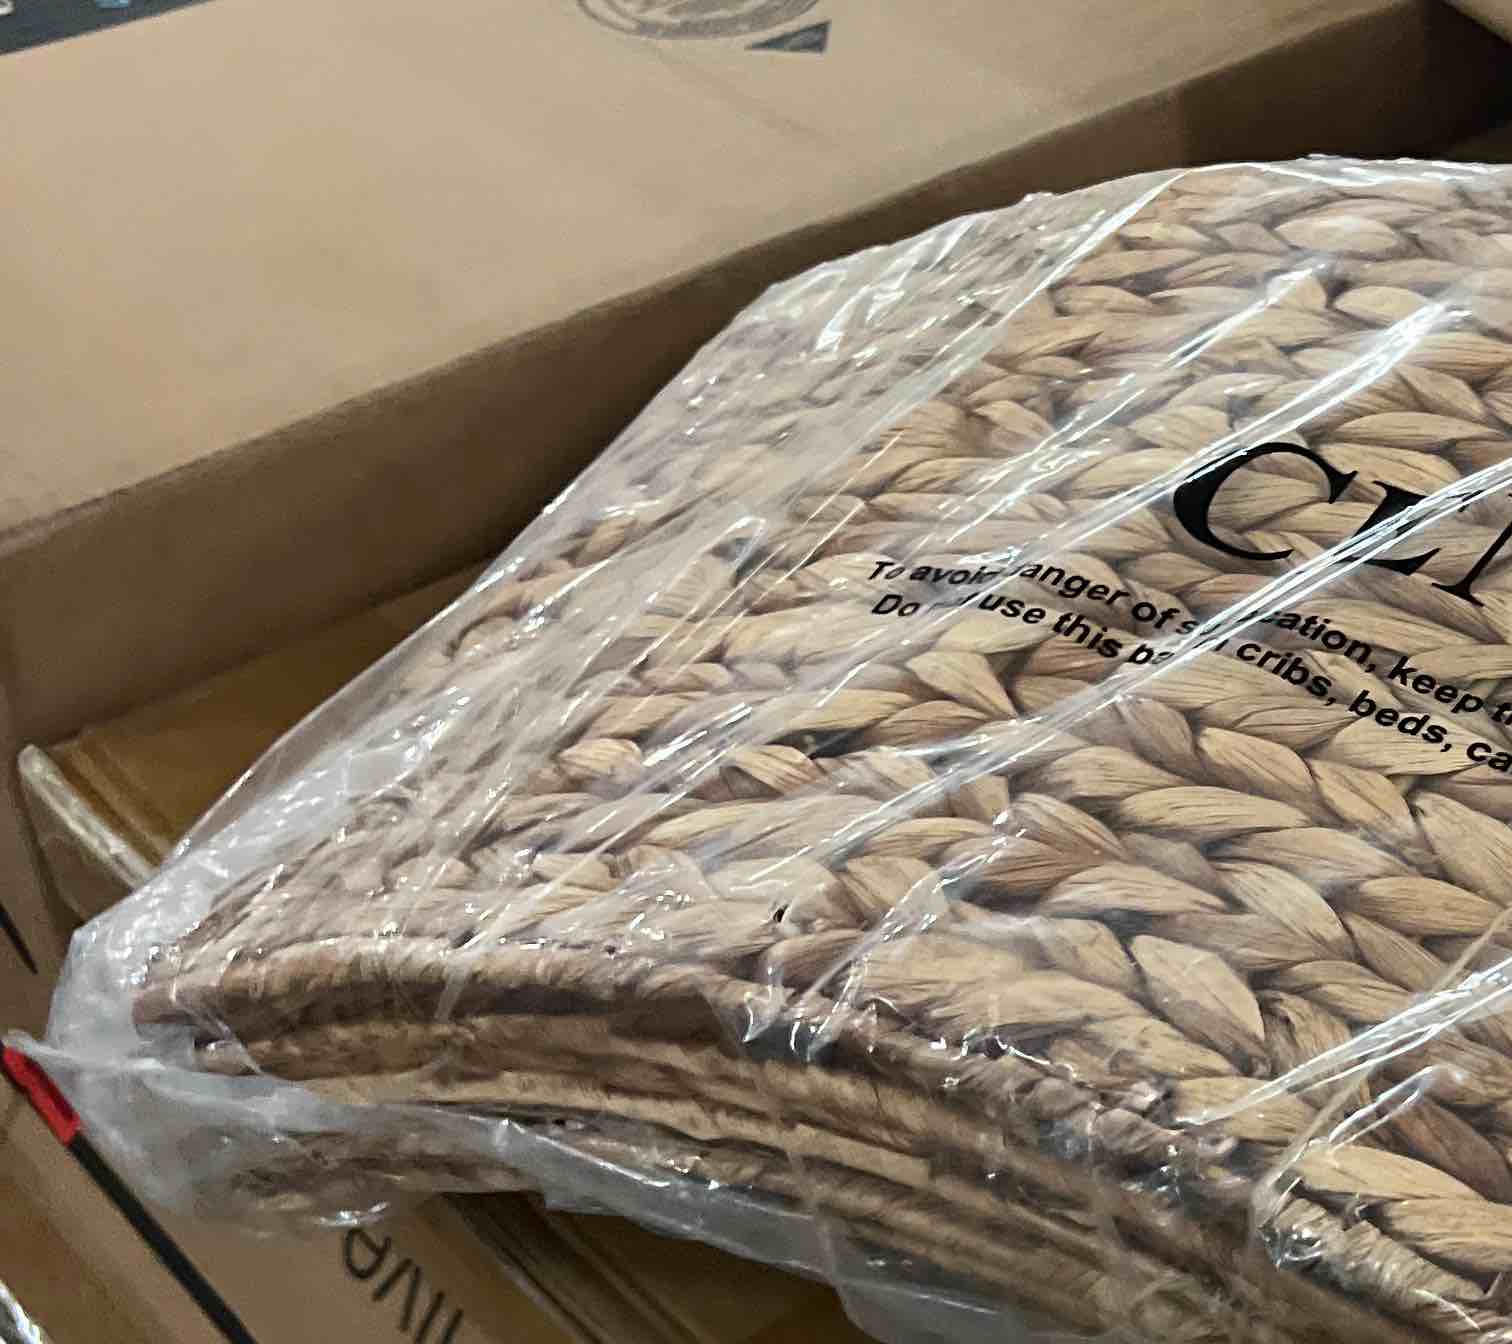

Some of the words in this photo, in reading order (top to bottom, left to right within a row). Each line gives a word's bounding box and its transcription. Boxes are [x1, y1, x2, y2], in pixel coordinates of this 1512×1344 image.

[867, 560, 906, 581] To
[1131, 601, 1180, 630] of
[1388, 655, 1484, 715] keep
[870, 593, 922, 618] Do
[977, 593, 1047, 626] use
[1051, 610, 1124, 660] this
[1236, 641, 1337, 707] cribs,
[1348, 689, 1454, 753] beds,
